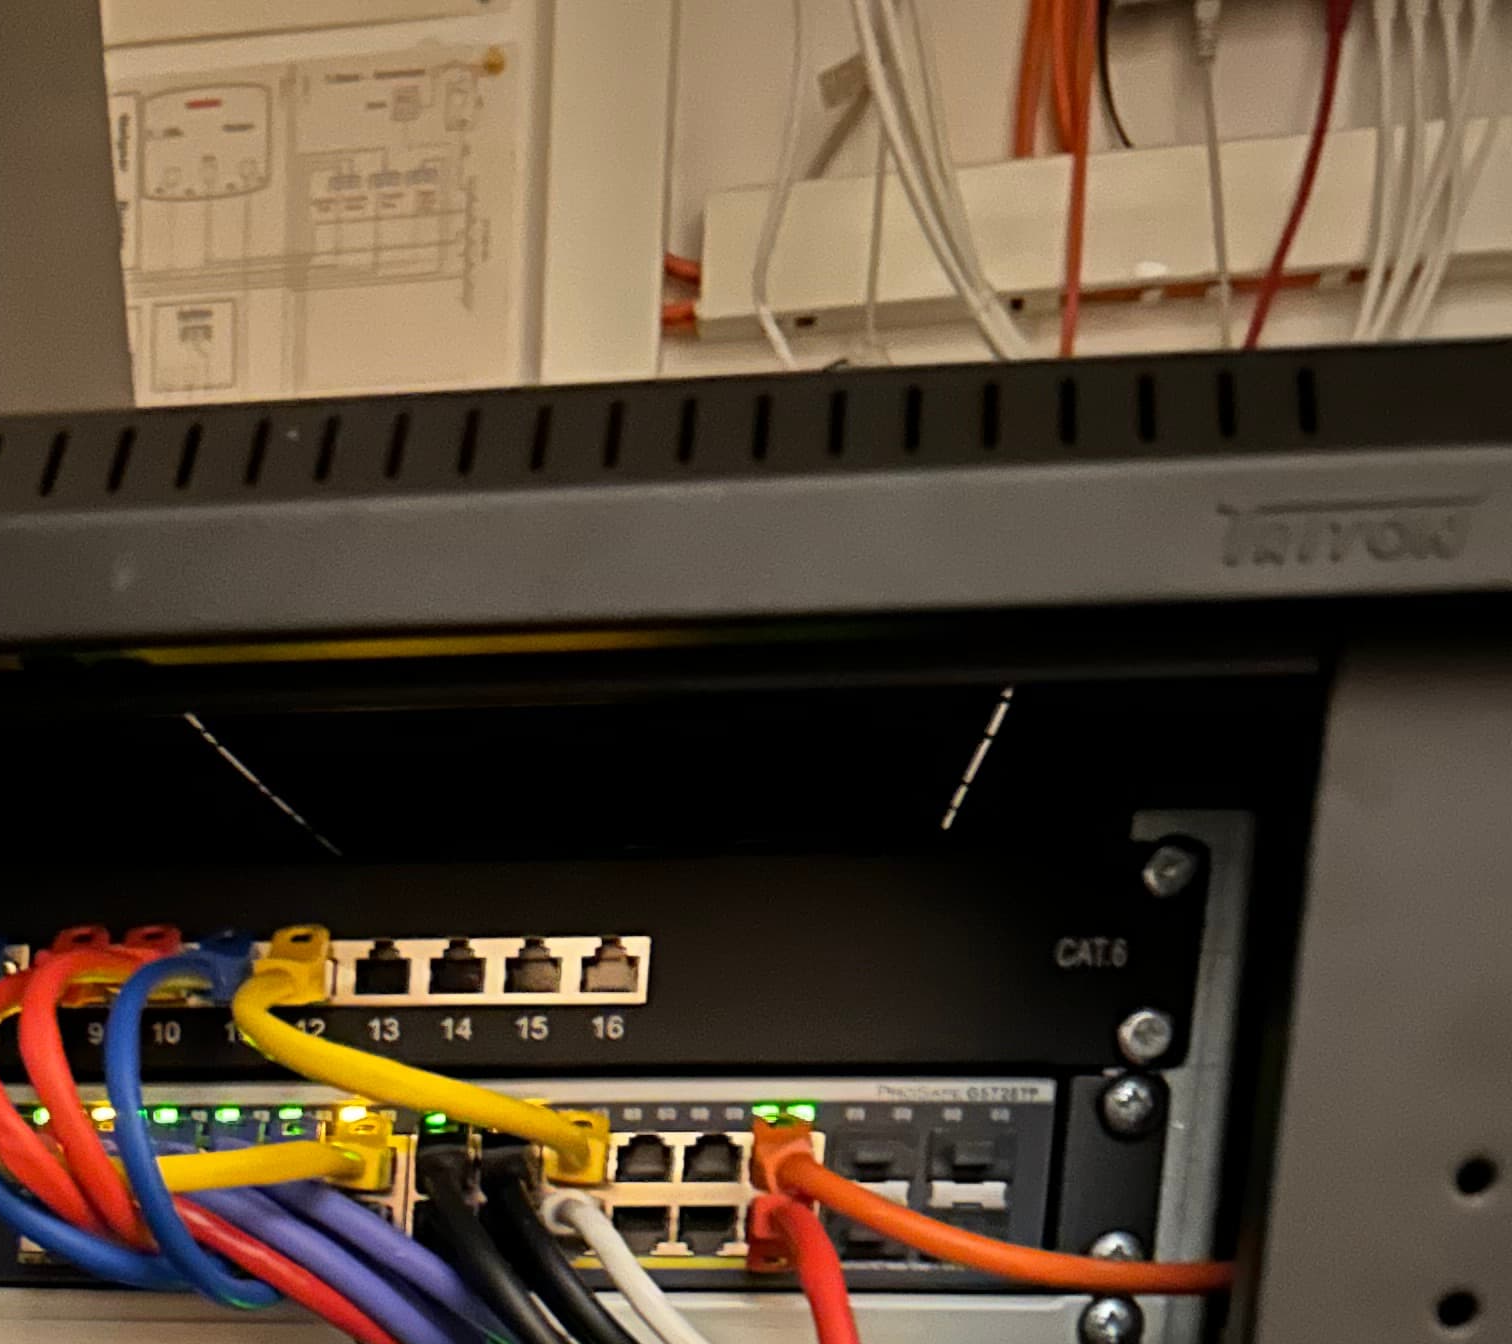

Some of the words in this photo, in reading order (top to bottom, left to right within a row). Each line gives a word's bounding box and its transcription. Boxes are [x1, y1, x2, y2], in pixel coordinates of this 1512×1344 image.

[1054, 937, 1130, 970] CAT.6
[88, 1022, 104, 1044] 9
[152, 1022, 181, 1044] 10
[367, 1017, 401, 1042] 13
[440, 1017, 474, 1041] 14
[515, 1015, 549, 1041] 15
[592, 1014, 625, 1040] 16
